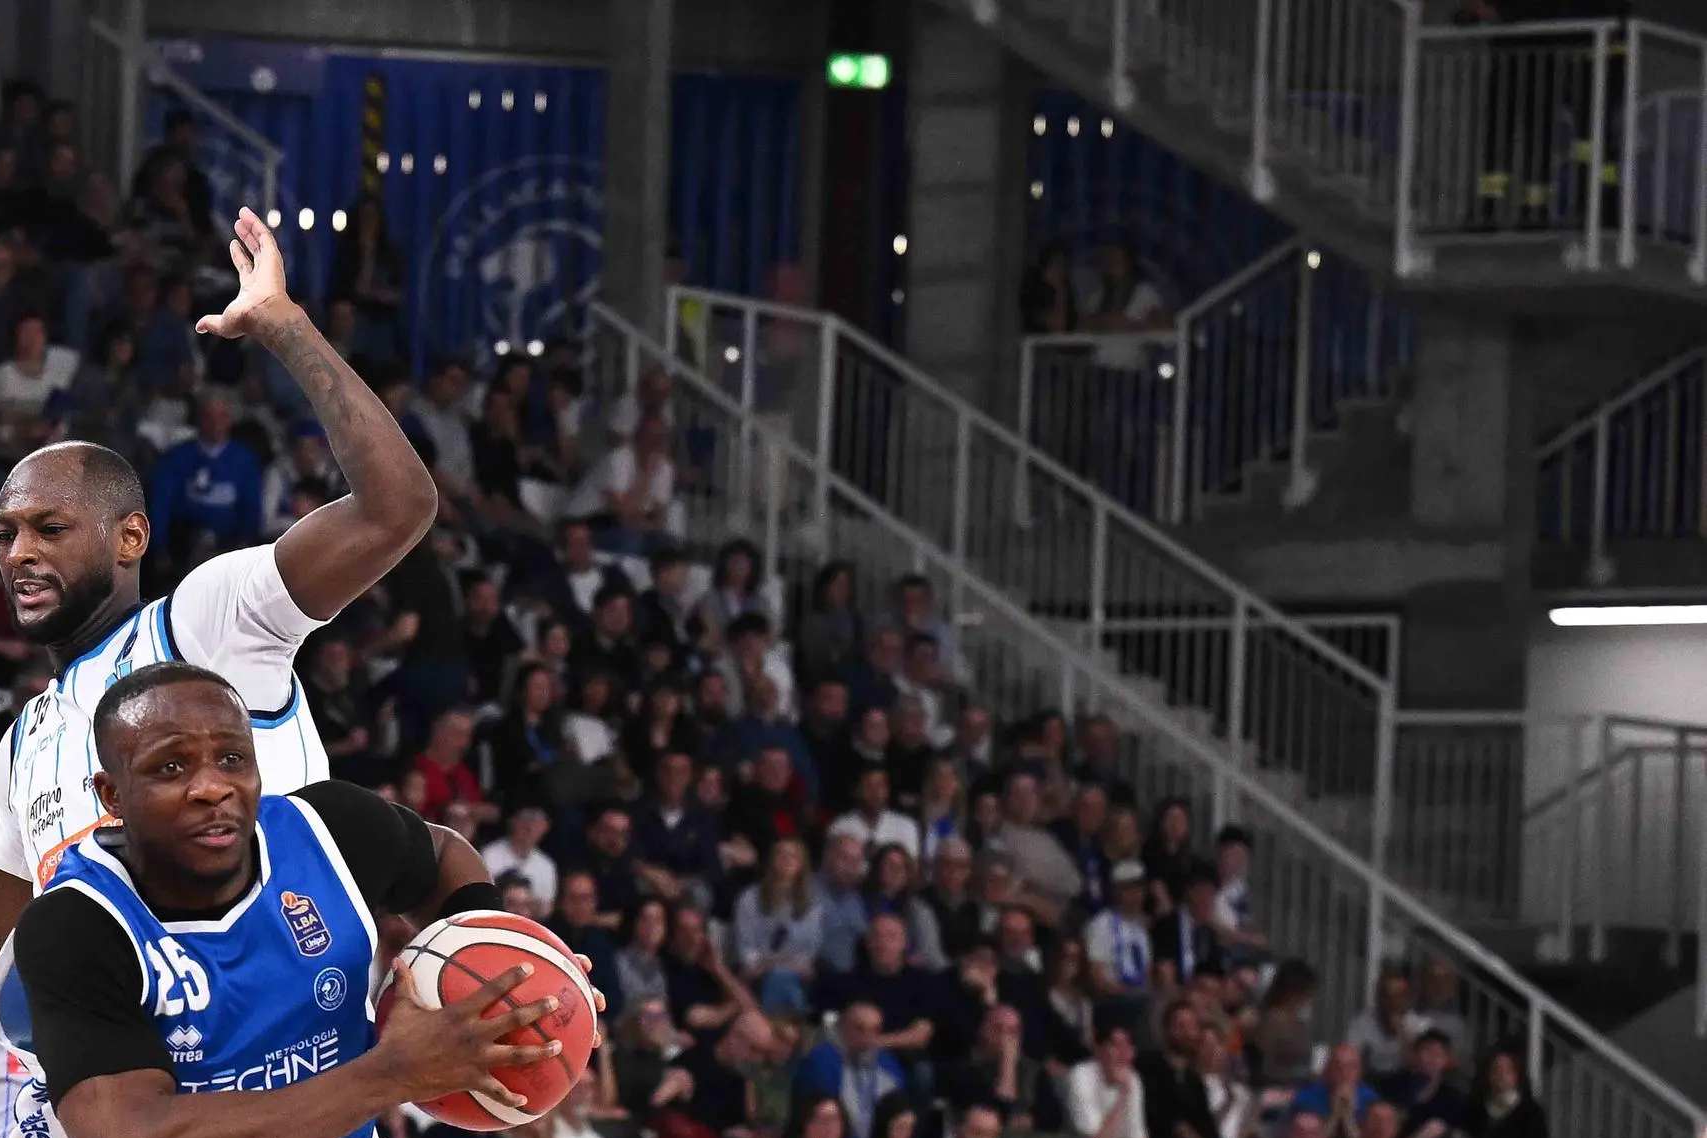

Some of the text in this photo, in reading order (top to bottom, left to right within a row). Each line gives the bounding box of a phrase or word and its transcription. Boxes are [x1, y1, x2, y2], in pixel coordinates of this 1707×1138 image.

[292, 912, 319, 932] LBA
[145, 935, 211, 1017] 25
[169, 1050, 204, 1063] rrea
[264, 1027, 338, 1063] METROLOGIA
